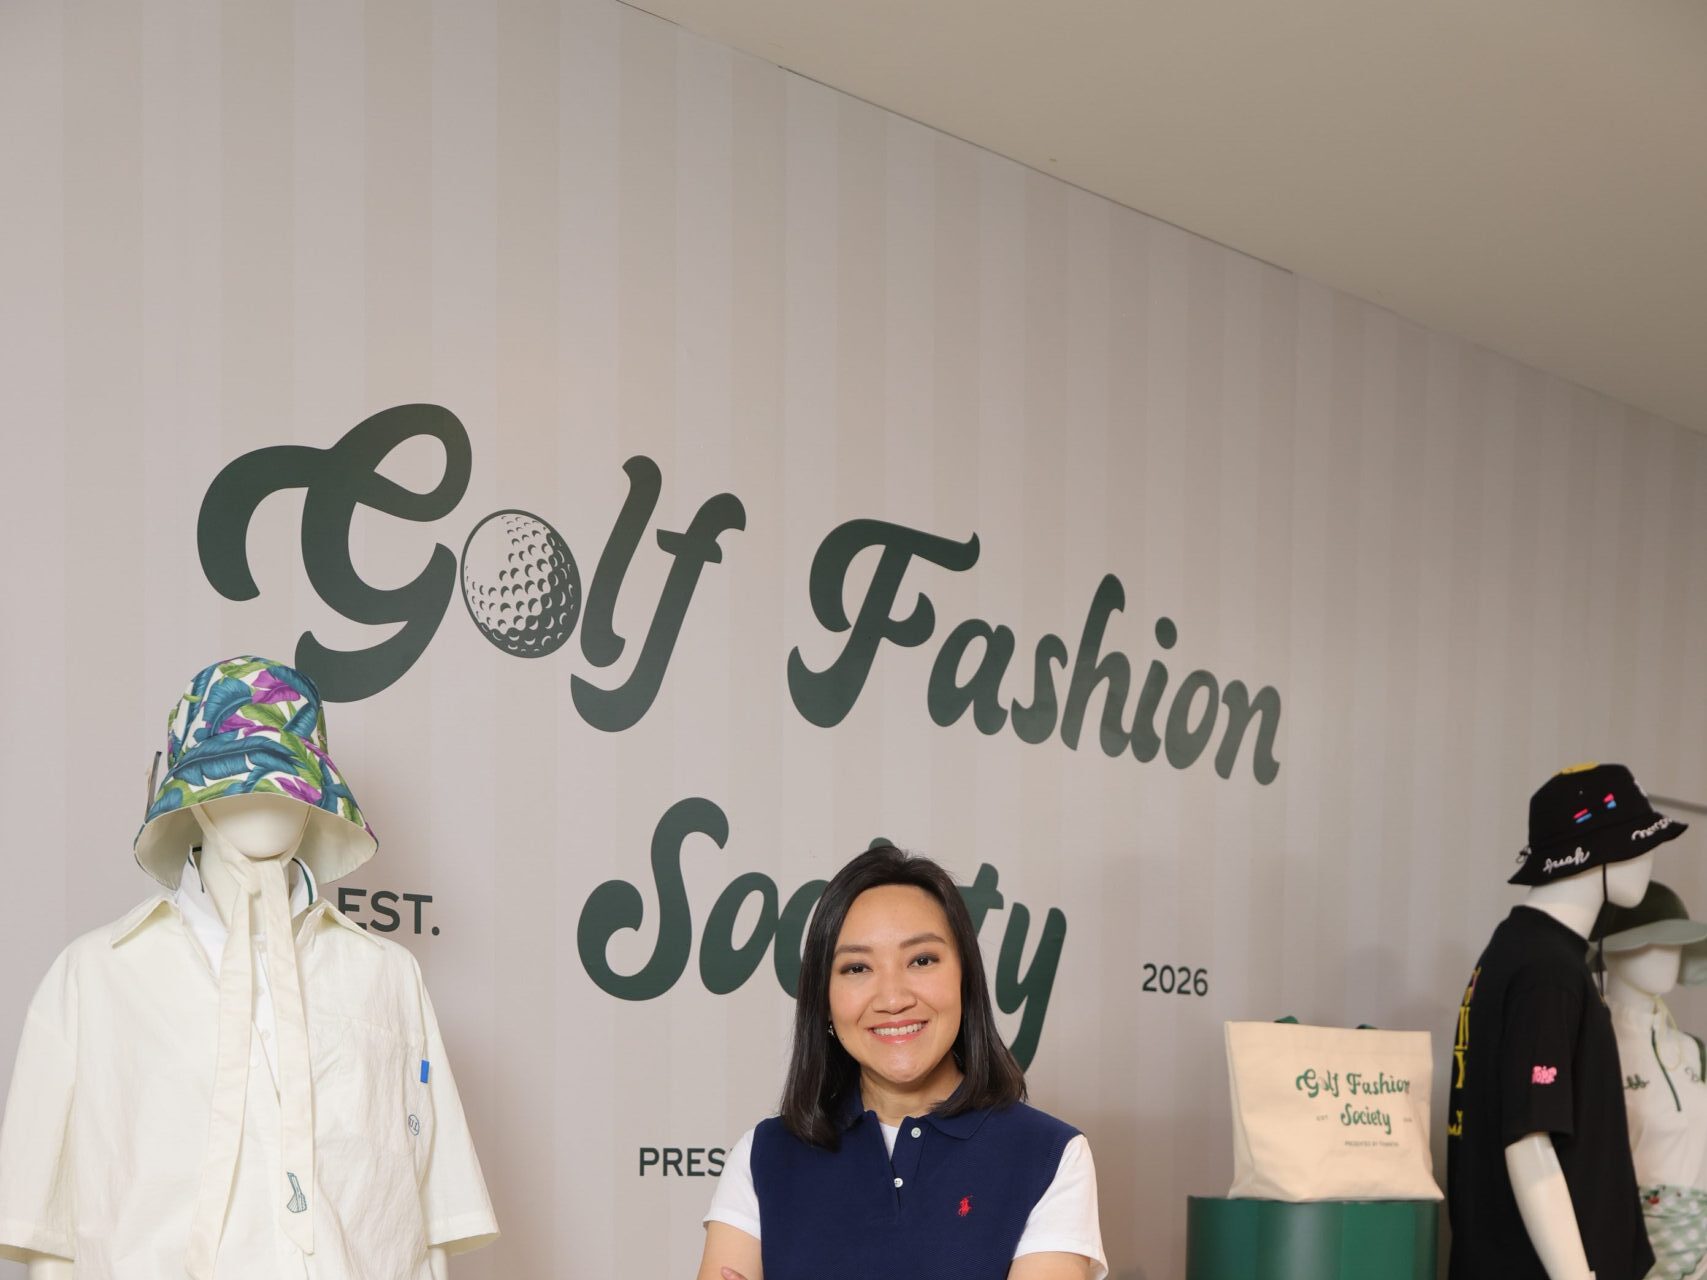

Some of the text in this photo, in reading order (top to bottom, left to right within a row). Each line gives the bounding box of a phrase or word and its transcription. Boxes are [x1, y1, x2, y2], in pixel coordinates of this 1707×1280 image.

[196, 402, 1281, 786] Golf Fashion
[337, 887, 440, 936] EST.
[1142, 963, 1209, 997] 2026
[1340, 1102, 1392, 1136] Society
